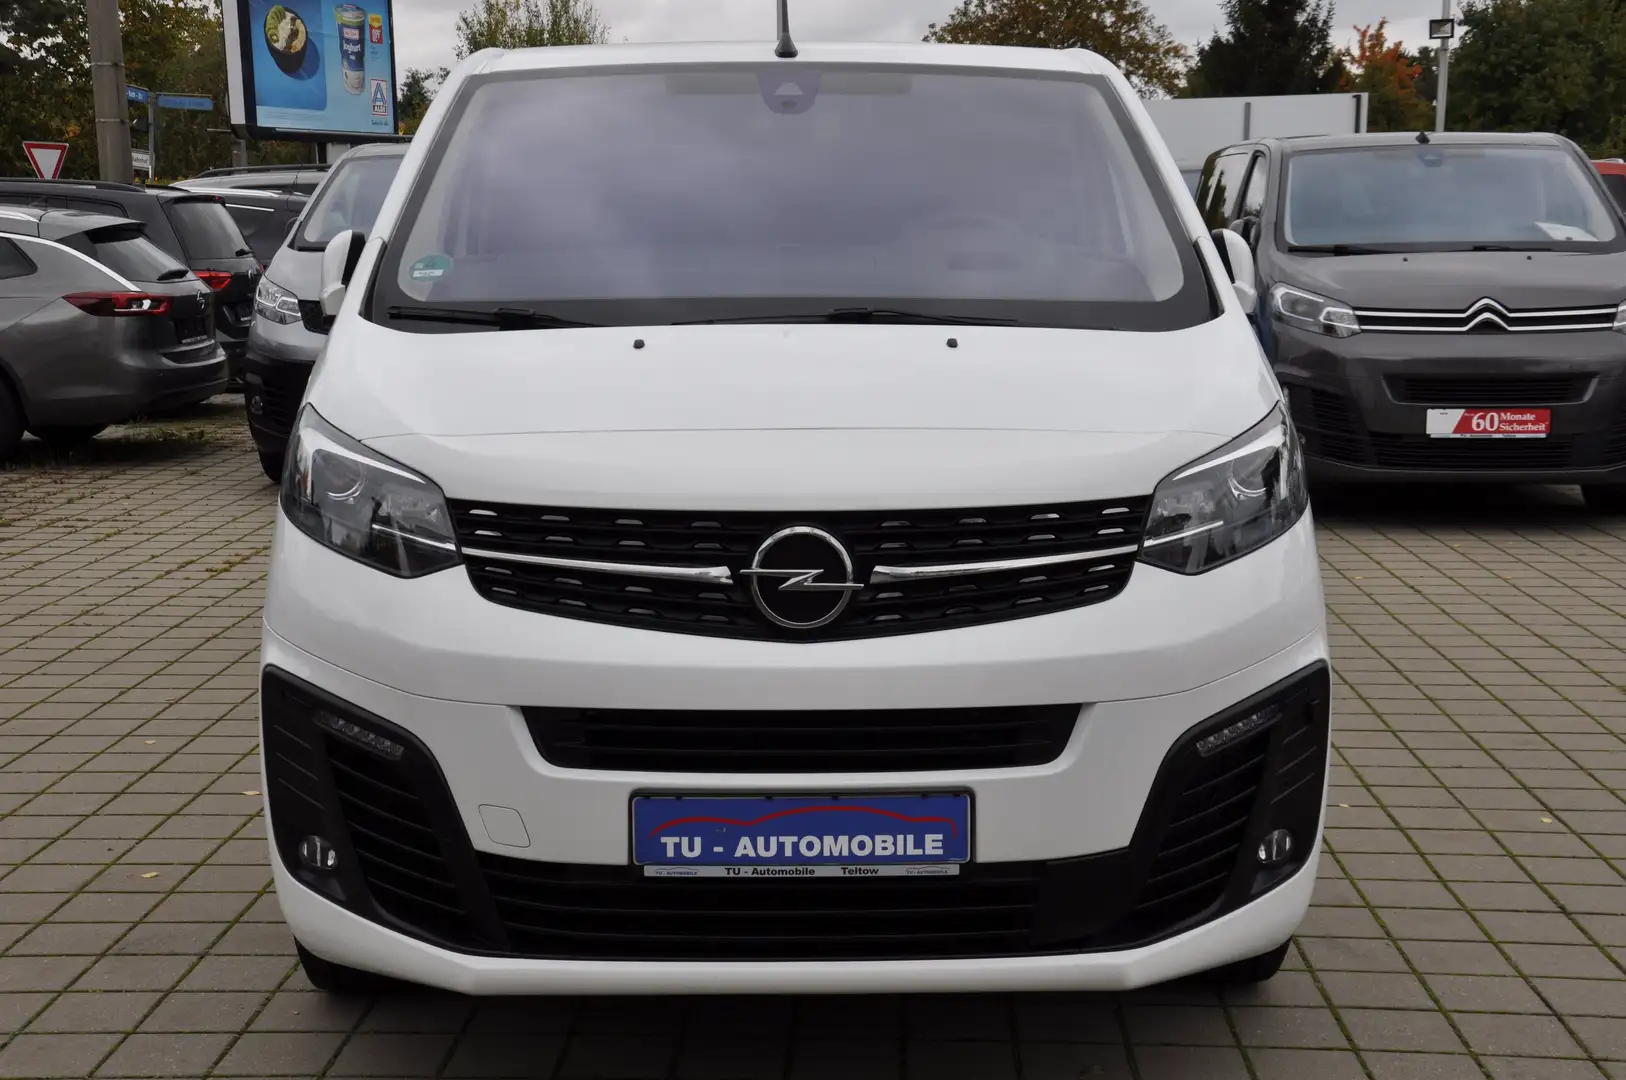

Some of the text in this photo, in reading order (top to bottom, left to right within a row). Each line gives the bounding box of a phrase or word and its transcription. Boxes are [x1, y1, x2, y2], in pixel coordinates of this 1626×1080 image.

[1472, 412, 1499, 431] 60
[1500, 412, 1536, 421] Monate
[1499, 422, 1545, 431] Sicherheit
[660, 836, 702, 858] TU
[733, 833, 944, 858] AUTOMOBILE
[725, 868, 741, 876] TU
[751, 867, 816, 876] Automobile
[840, 866, 880, 875] Teltow
